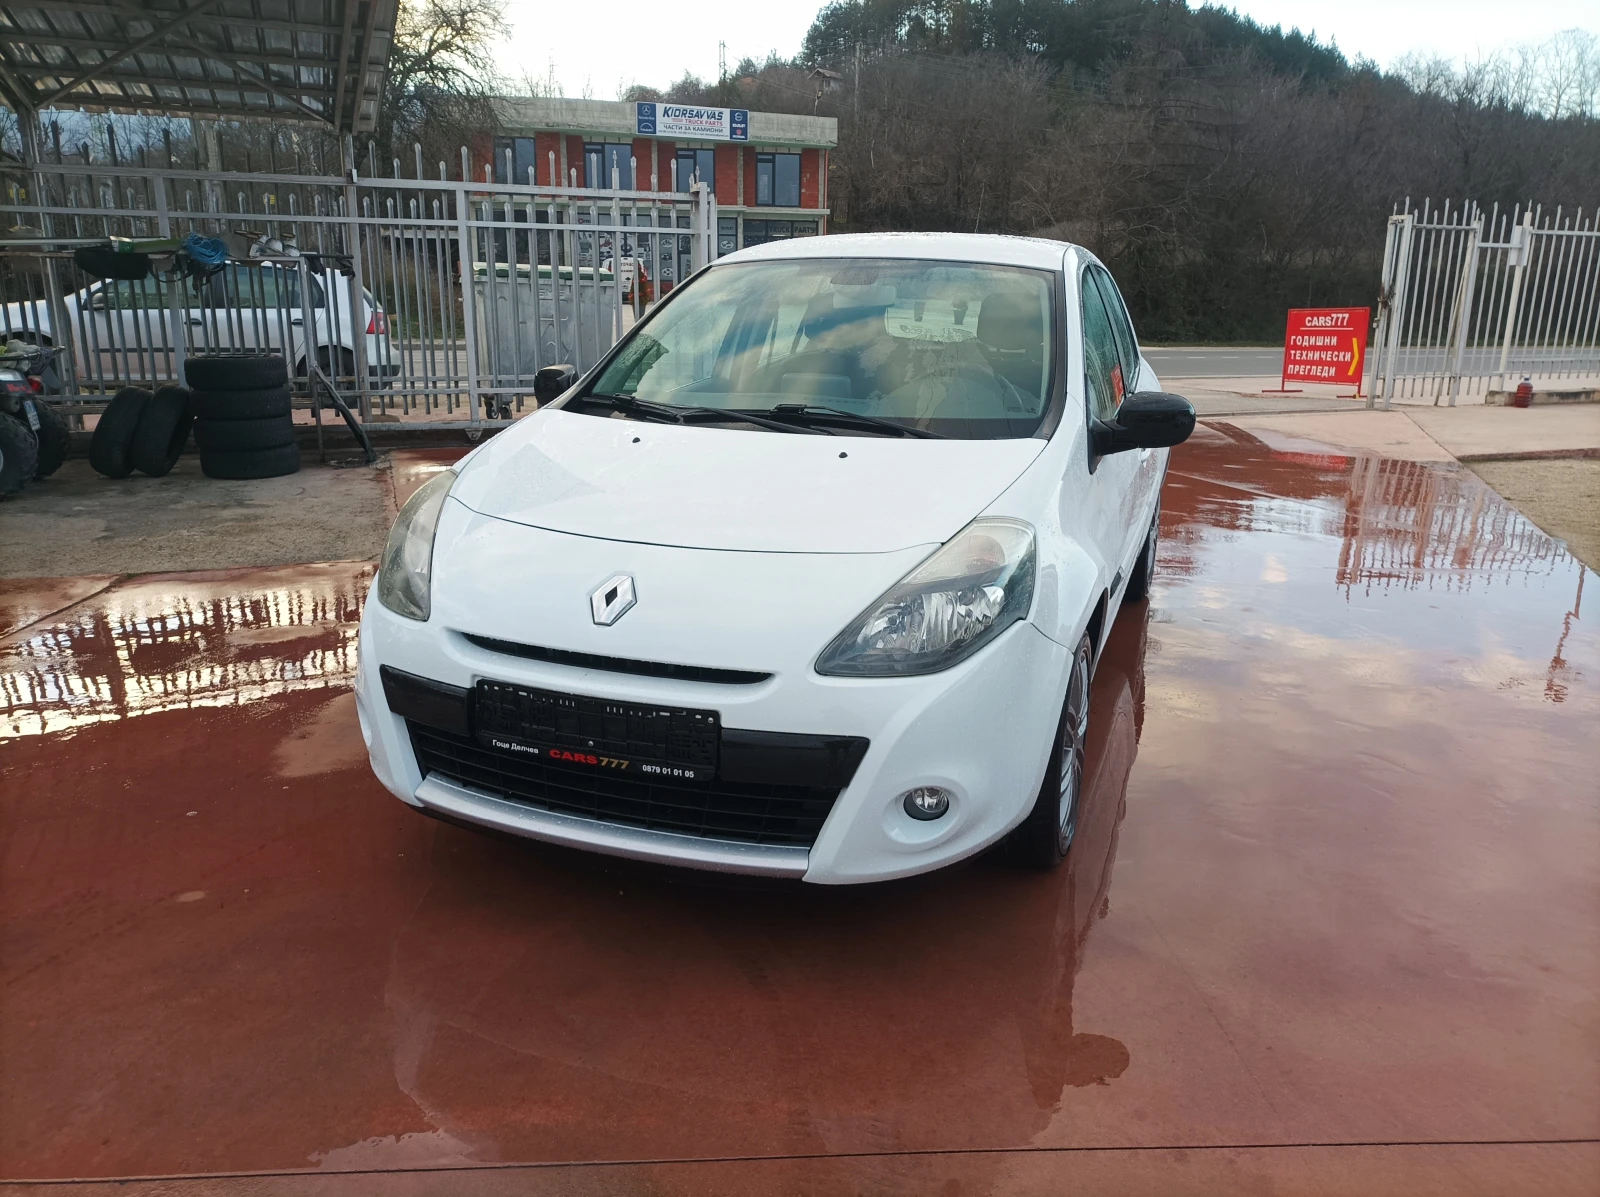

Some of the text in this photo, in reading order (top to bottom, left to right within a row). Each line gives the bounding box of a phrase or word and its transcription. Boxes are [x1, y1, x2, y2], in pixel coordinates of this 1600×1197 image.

[685, 118, 704, 126] TRUCK
[794, 226, 815, 234] PARTS
[1305, 313, 1349, 327] CARS777
[1290, 335, 1338, 347] ГОДИШНИ
[1290, 350, 1352, 362] ТЕХНИЧЕСКИ
[1287, 364, 1336, 378] ПРЕГЛЕДИ
[492, 739, 539, 754] Гоце Делчев
[642, 764, 695, 778] 0879 01 01 05
